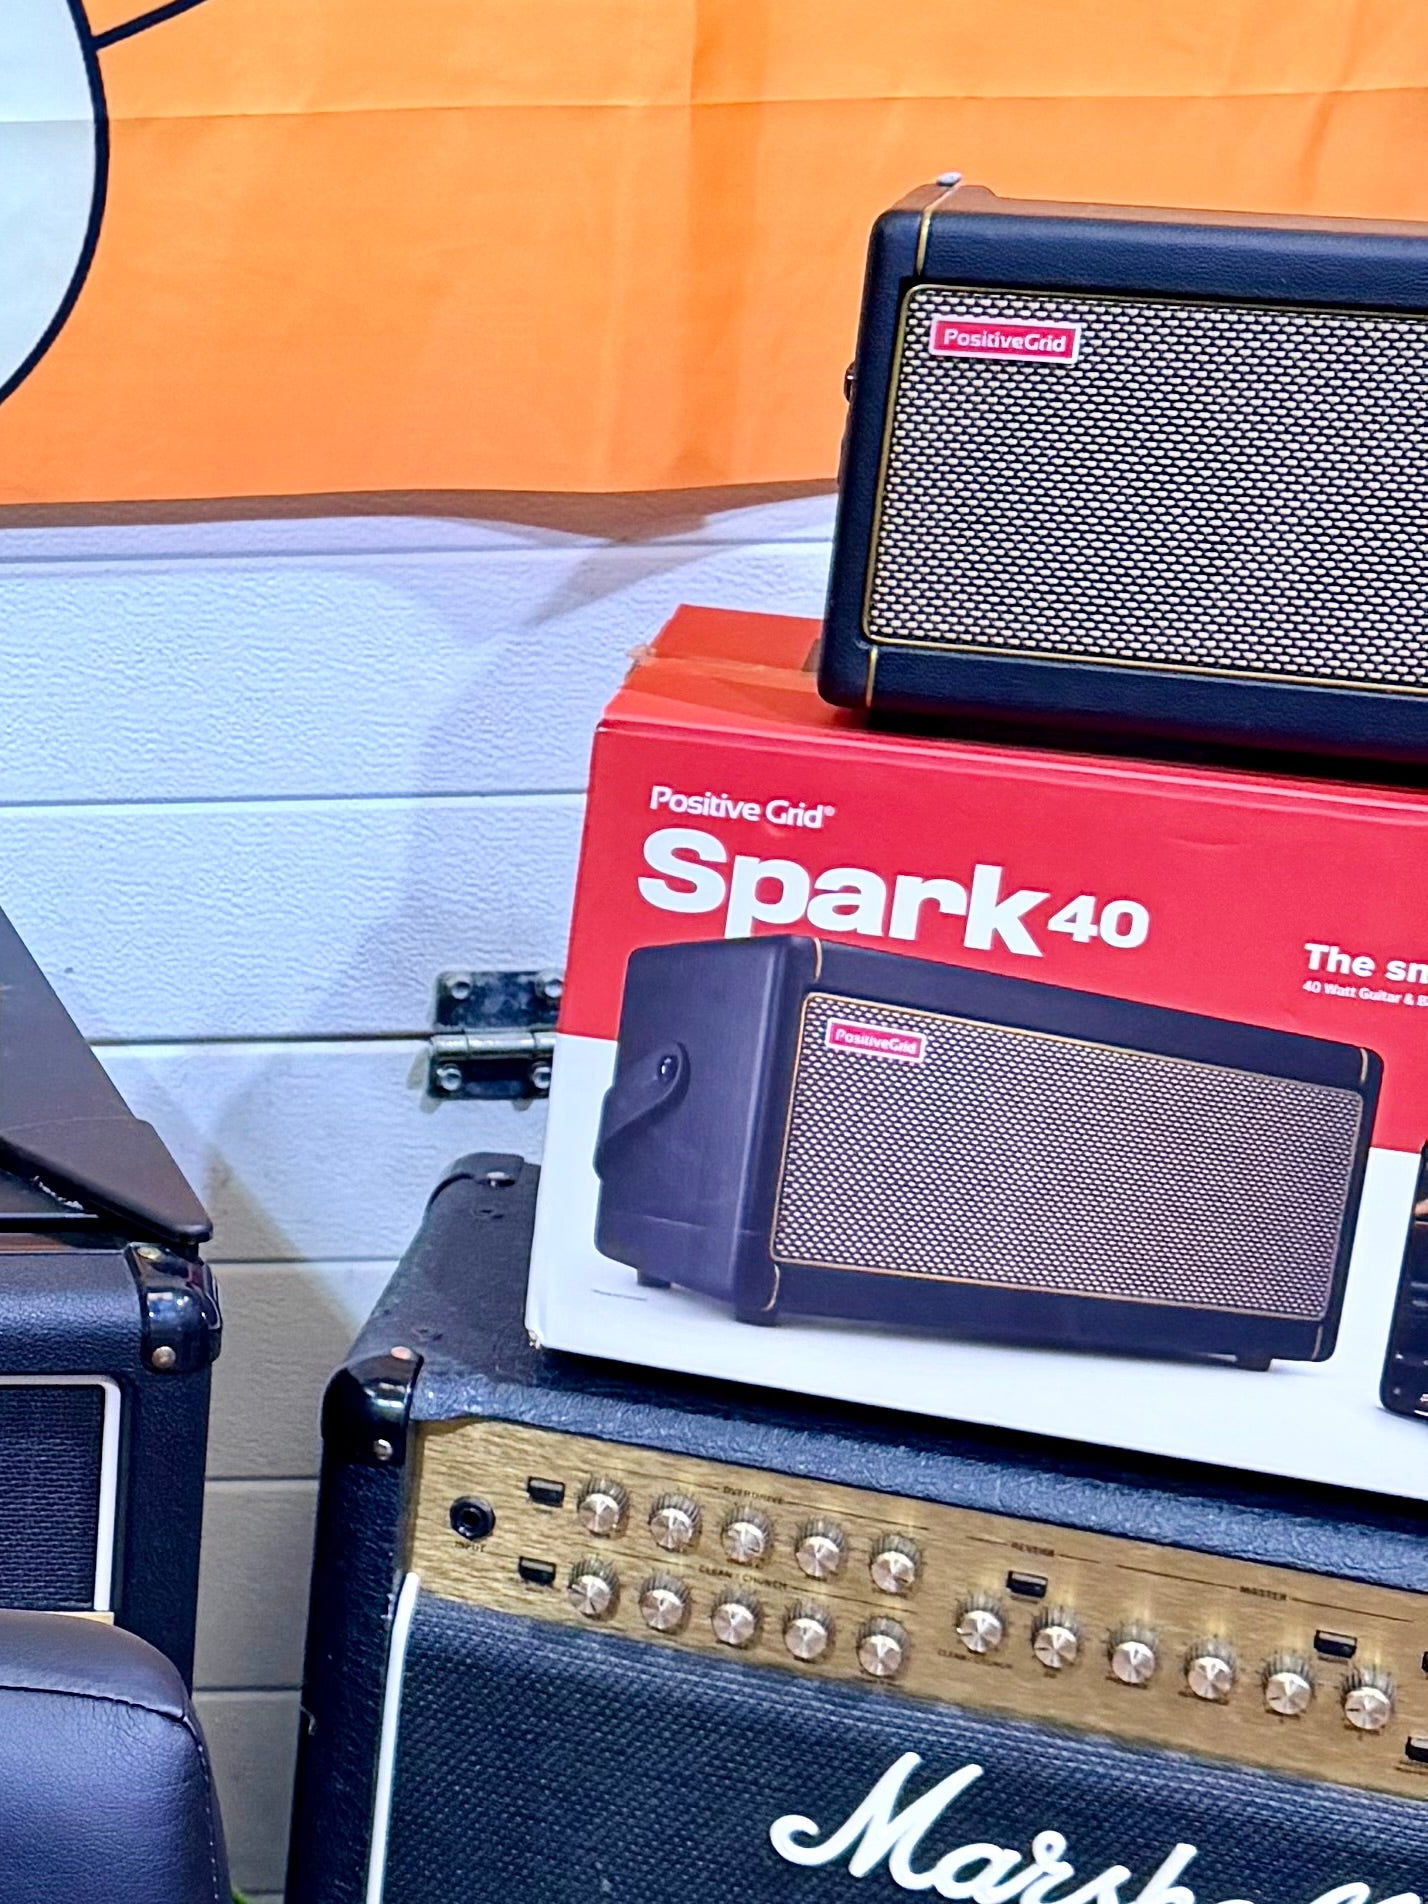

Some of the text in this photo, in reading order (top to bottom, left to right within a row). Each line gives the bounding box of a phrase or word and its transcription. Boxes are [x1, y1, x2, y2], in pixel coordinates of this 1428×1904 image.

[944, 327, 1067, 353] PositiveGrid
[650, 785, 761, 822] Positive
[638, 828, 1150, 957] Spark 40
[1304, 942, 1376, 977] The
[1302, 980, 1322, 994] 40
[1324, 982, 1357, 999] Watt
[1358, 987, 1403, 1004] Guitar
